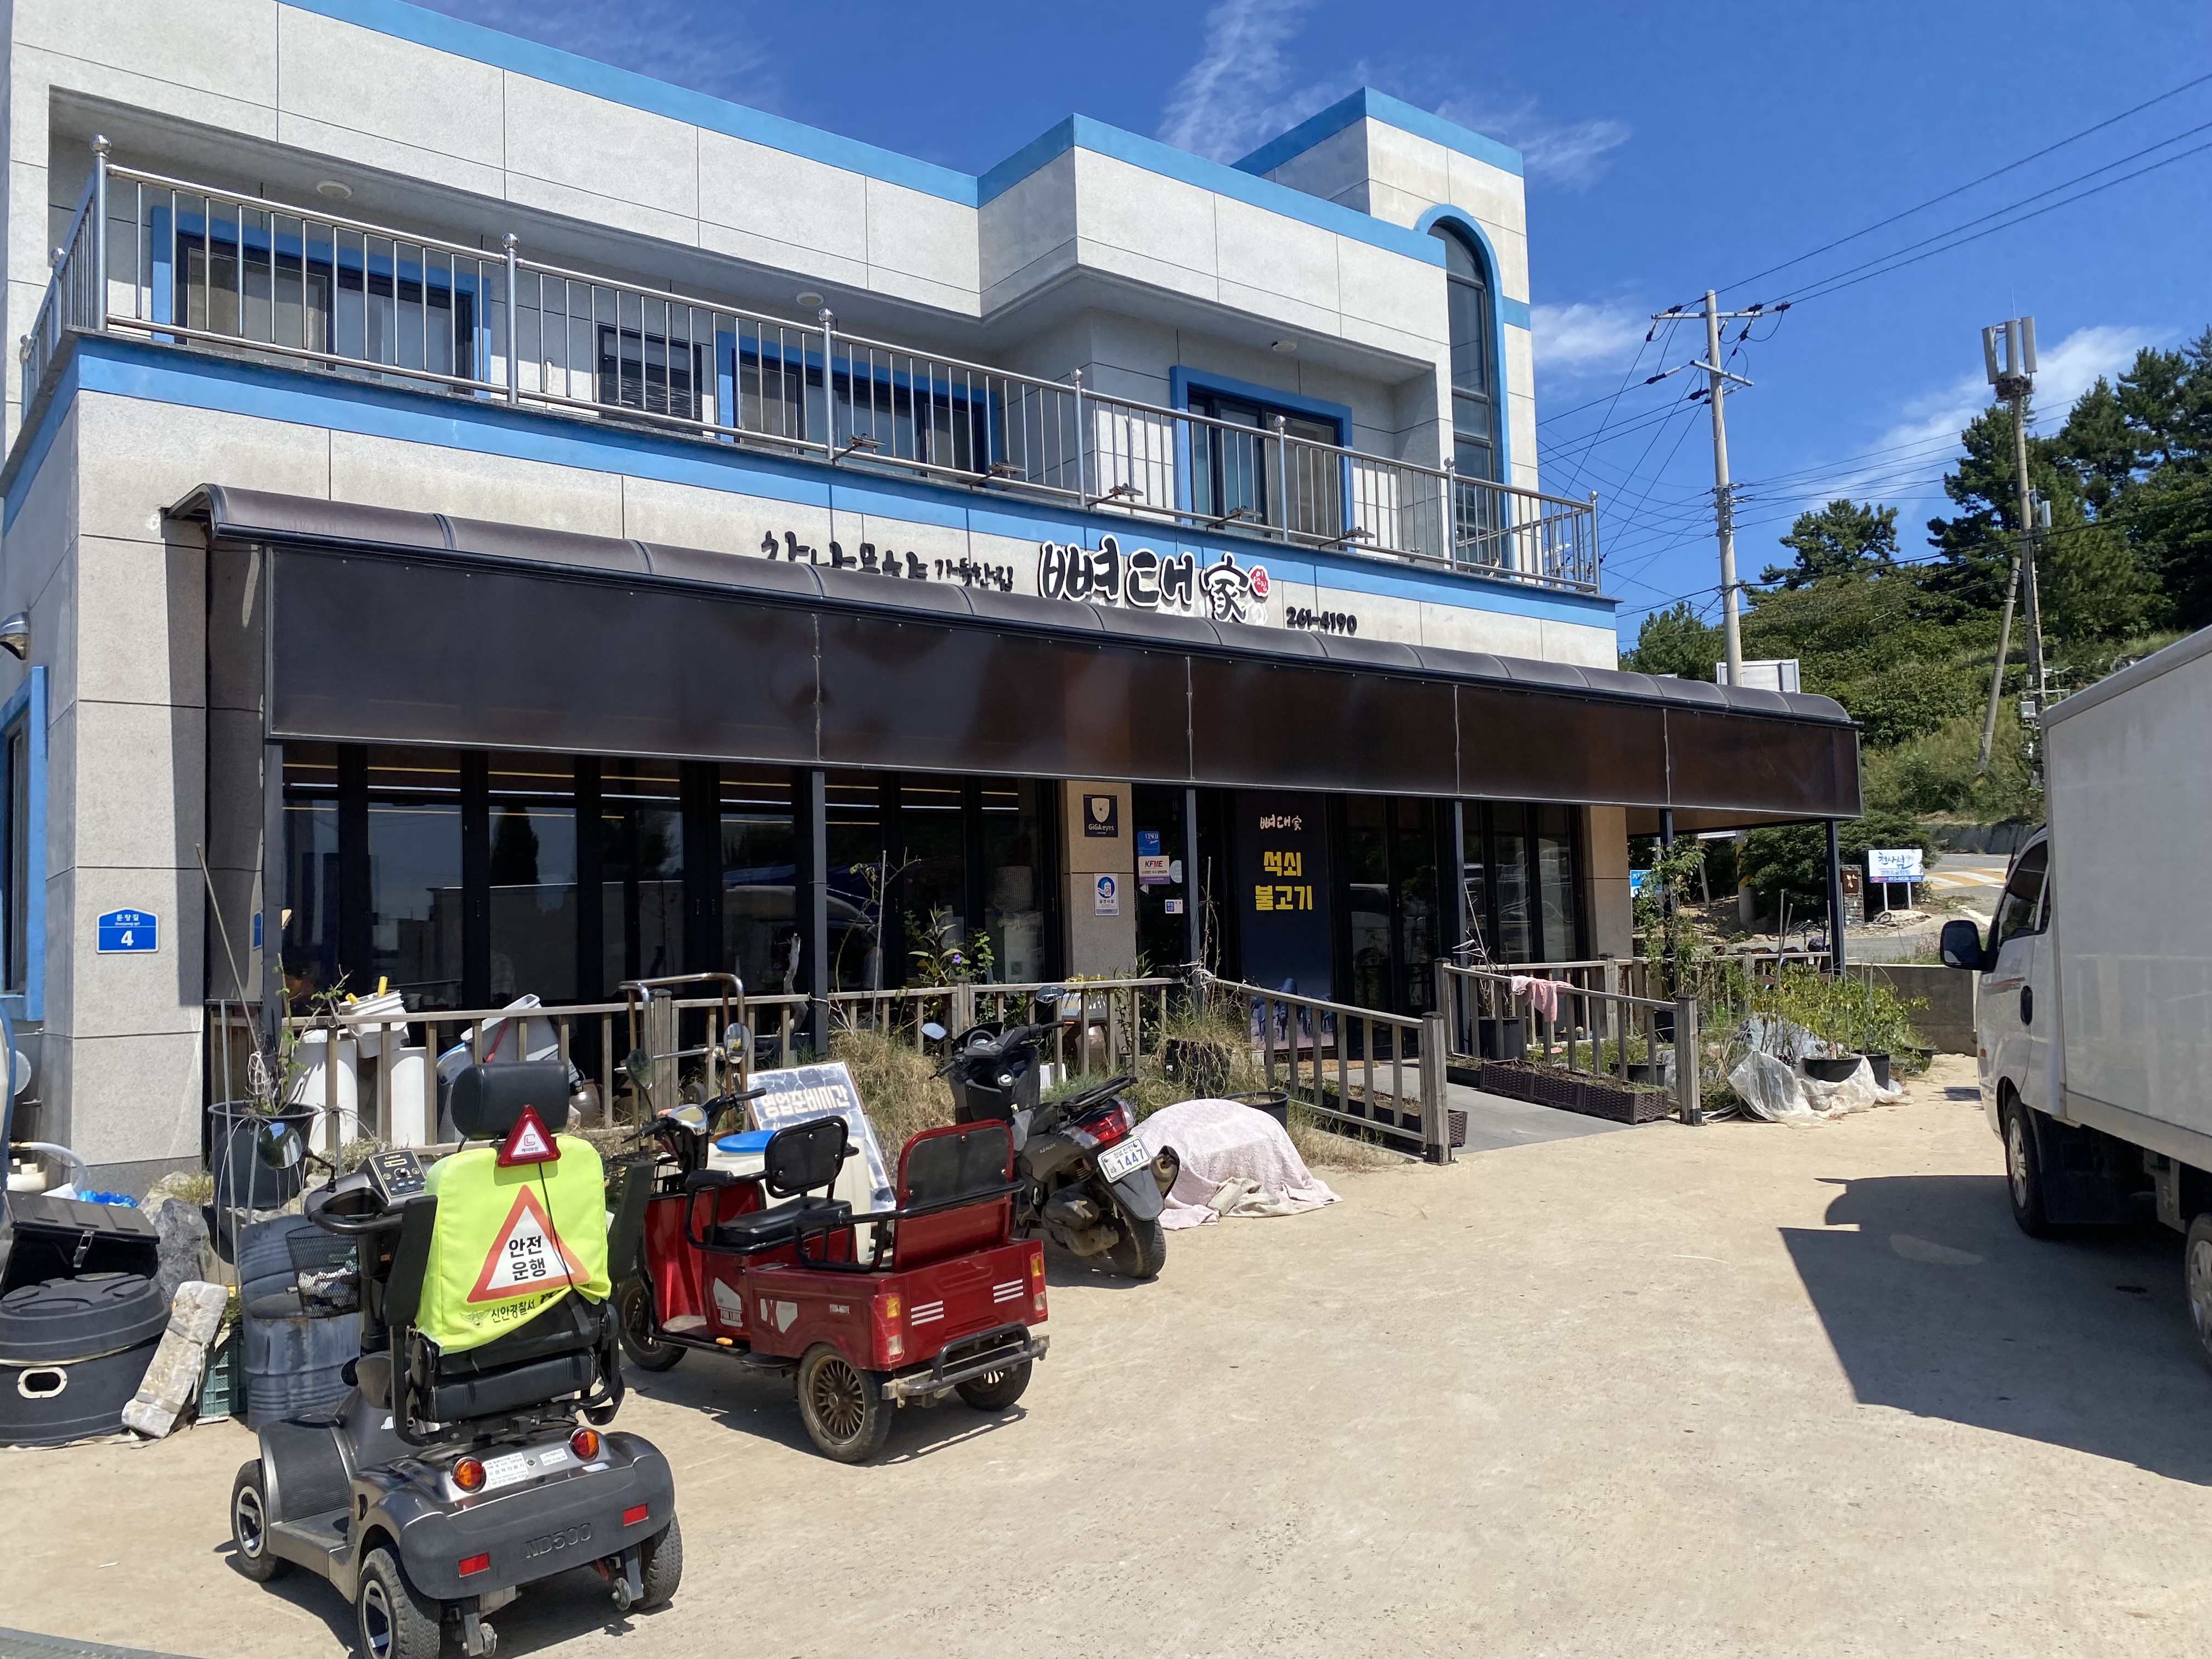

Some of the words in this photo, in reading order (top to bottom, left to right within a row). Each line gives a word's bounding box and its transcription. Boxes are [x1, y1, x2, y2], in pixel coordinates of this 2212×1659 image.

[1286, 606, 1357, 635] 261-4190
[1263, 851, 1302, 876] 석쇠
[1255, 885, 1313, 911] 불고기
[121, 930, 134, 946] 4
[1113, 1149, 1124, 1158] 전남
[1122, 1144, 1134, 1154] 신안
[1117, 1148, 1145, 1170] 1447
[509, 1235, 542, 1257] 안전
[512, 1257, 546, 1281] 운행
[492, 1299, 535, 1323] 신안경찰서
